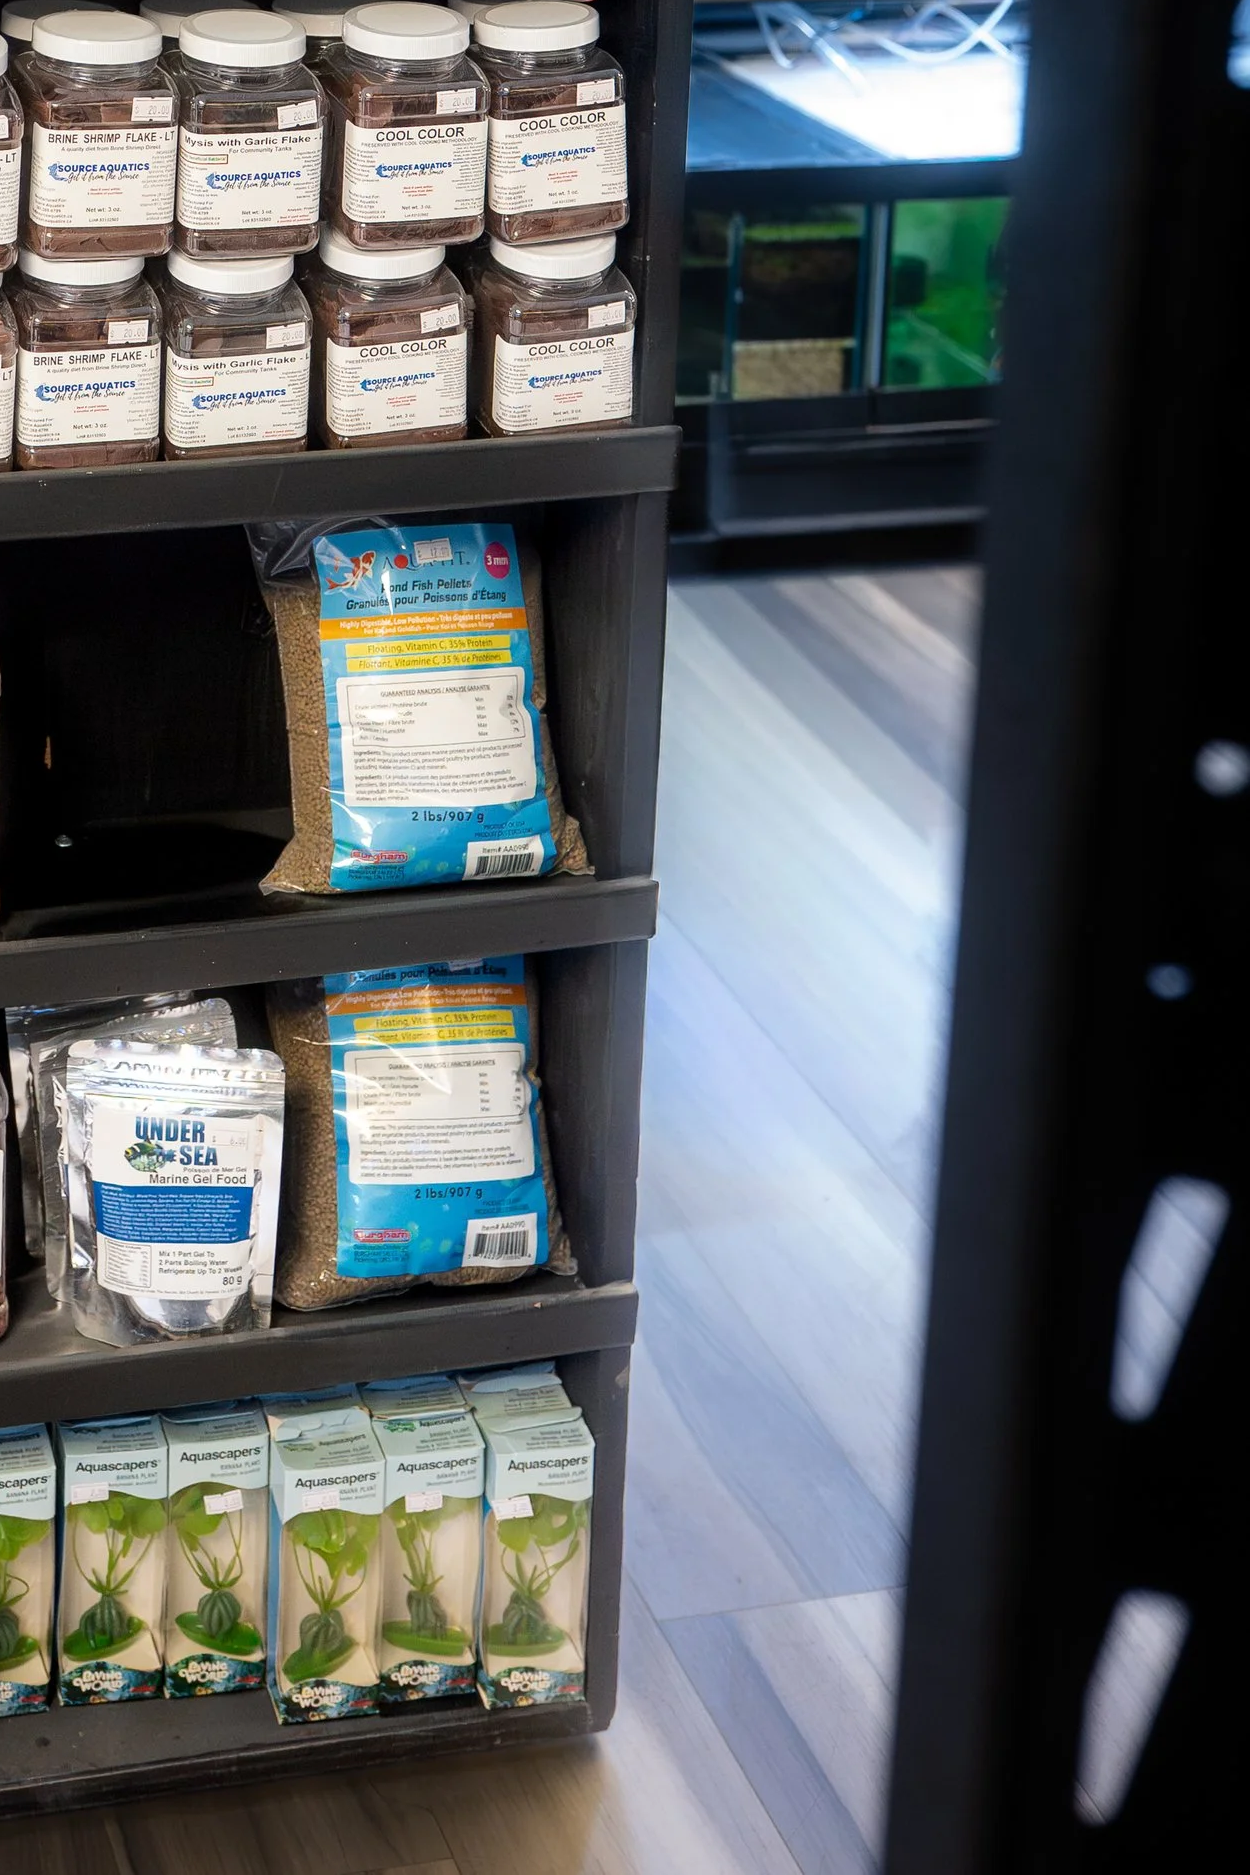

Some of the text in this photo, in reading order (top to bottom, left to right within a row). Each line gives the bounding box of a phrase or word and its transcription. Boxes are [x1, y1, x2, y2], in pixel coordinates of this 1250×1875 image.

[519, 111, 605, 131] COOL COLOR
[218, 135, 310, 147] with Garlic Flake
[6, 153, 16, 163] LT
[529, 337, 614, 357] COOL COLOR
[486, 555, 492, 565] 3
[412, 579, 471, 590] Fish Pellets
[394, 595, 419, 607] pour
[423, 592, 468, 603] Poissons
[412, 810, 484, 824] 2 lbs/907 g
[135, 1116, 205, 1143] UNDER
[179, 1146, 219, 1167] SEA
[149, 1174, 247, 1185] Marine Gel Food
[222, 1277, 243, 1288] 80 g
[180, 1446, 261, 1464] Aquascapers
[75, 1460, 158, 1475] Aquascapers
[397, 1458, 478, 1474] Aquascapers
[507, 1456, 589, 1473] Aquascapers
[295, 1472, 376, 1490] Aquascapers
